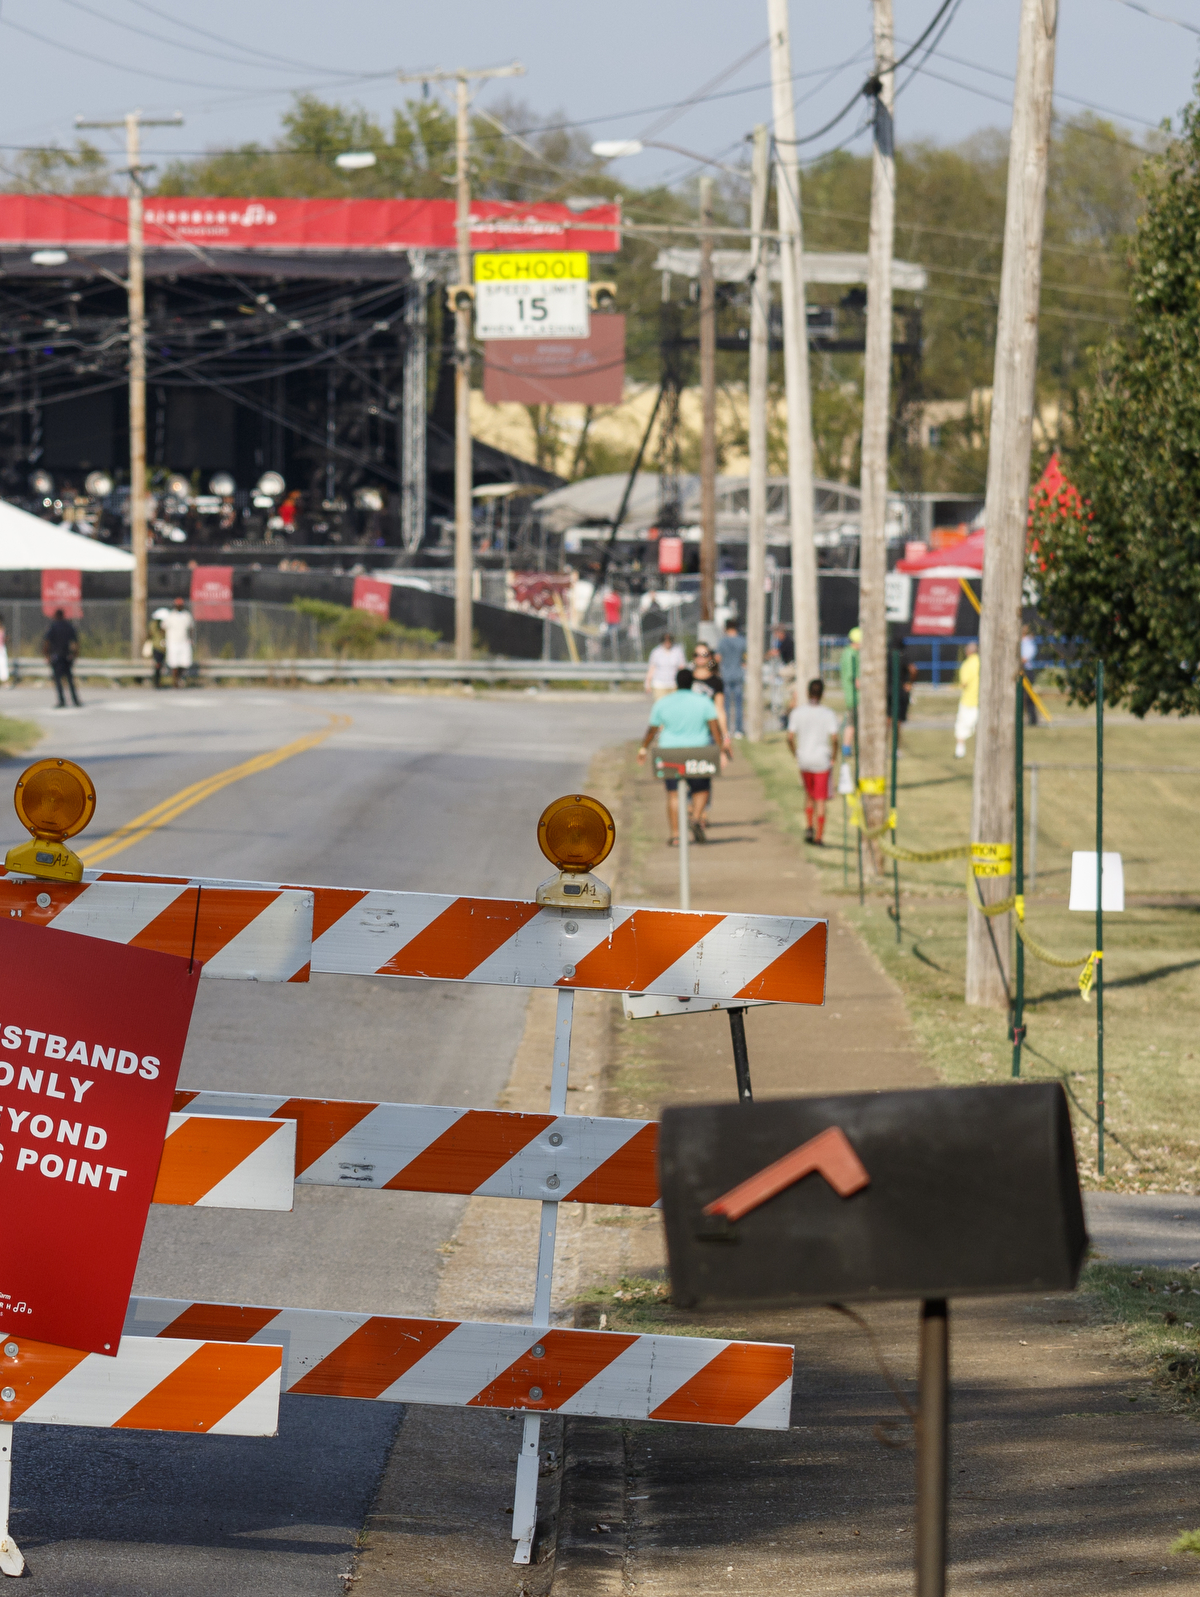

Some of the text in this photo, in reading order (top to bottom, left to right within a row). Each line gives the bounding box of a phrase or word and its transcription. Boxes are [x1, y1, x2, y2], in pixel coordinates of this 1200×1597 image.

[481, 260, 581, 280] SCHOOL
[486, 283, 578, 296] SPEED LIMIT
[517, 297, 548, 321] 15
[481, 325, 585, 336] WHEN FLASHING
[54, 853, 69, 867] A-1
[581, 882, 596, 896] A-1
[16, 1147, 128, 1192] POINT
